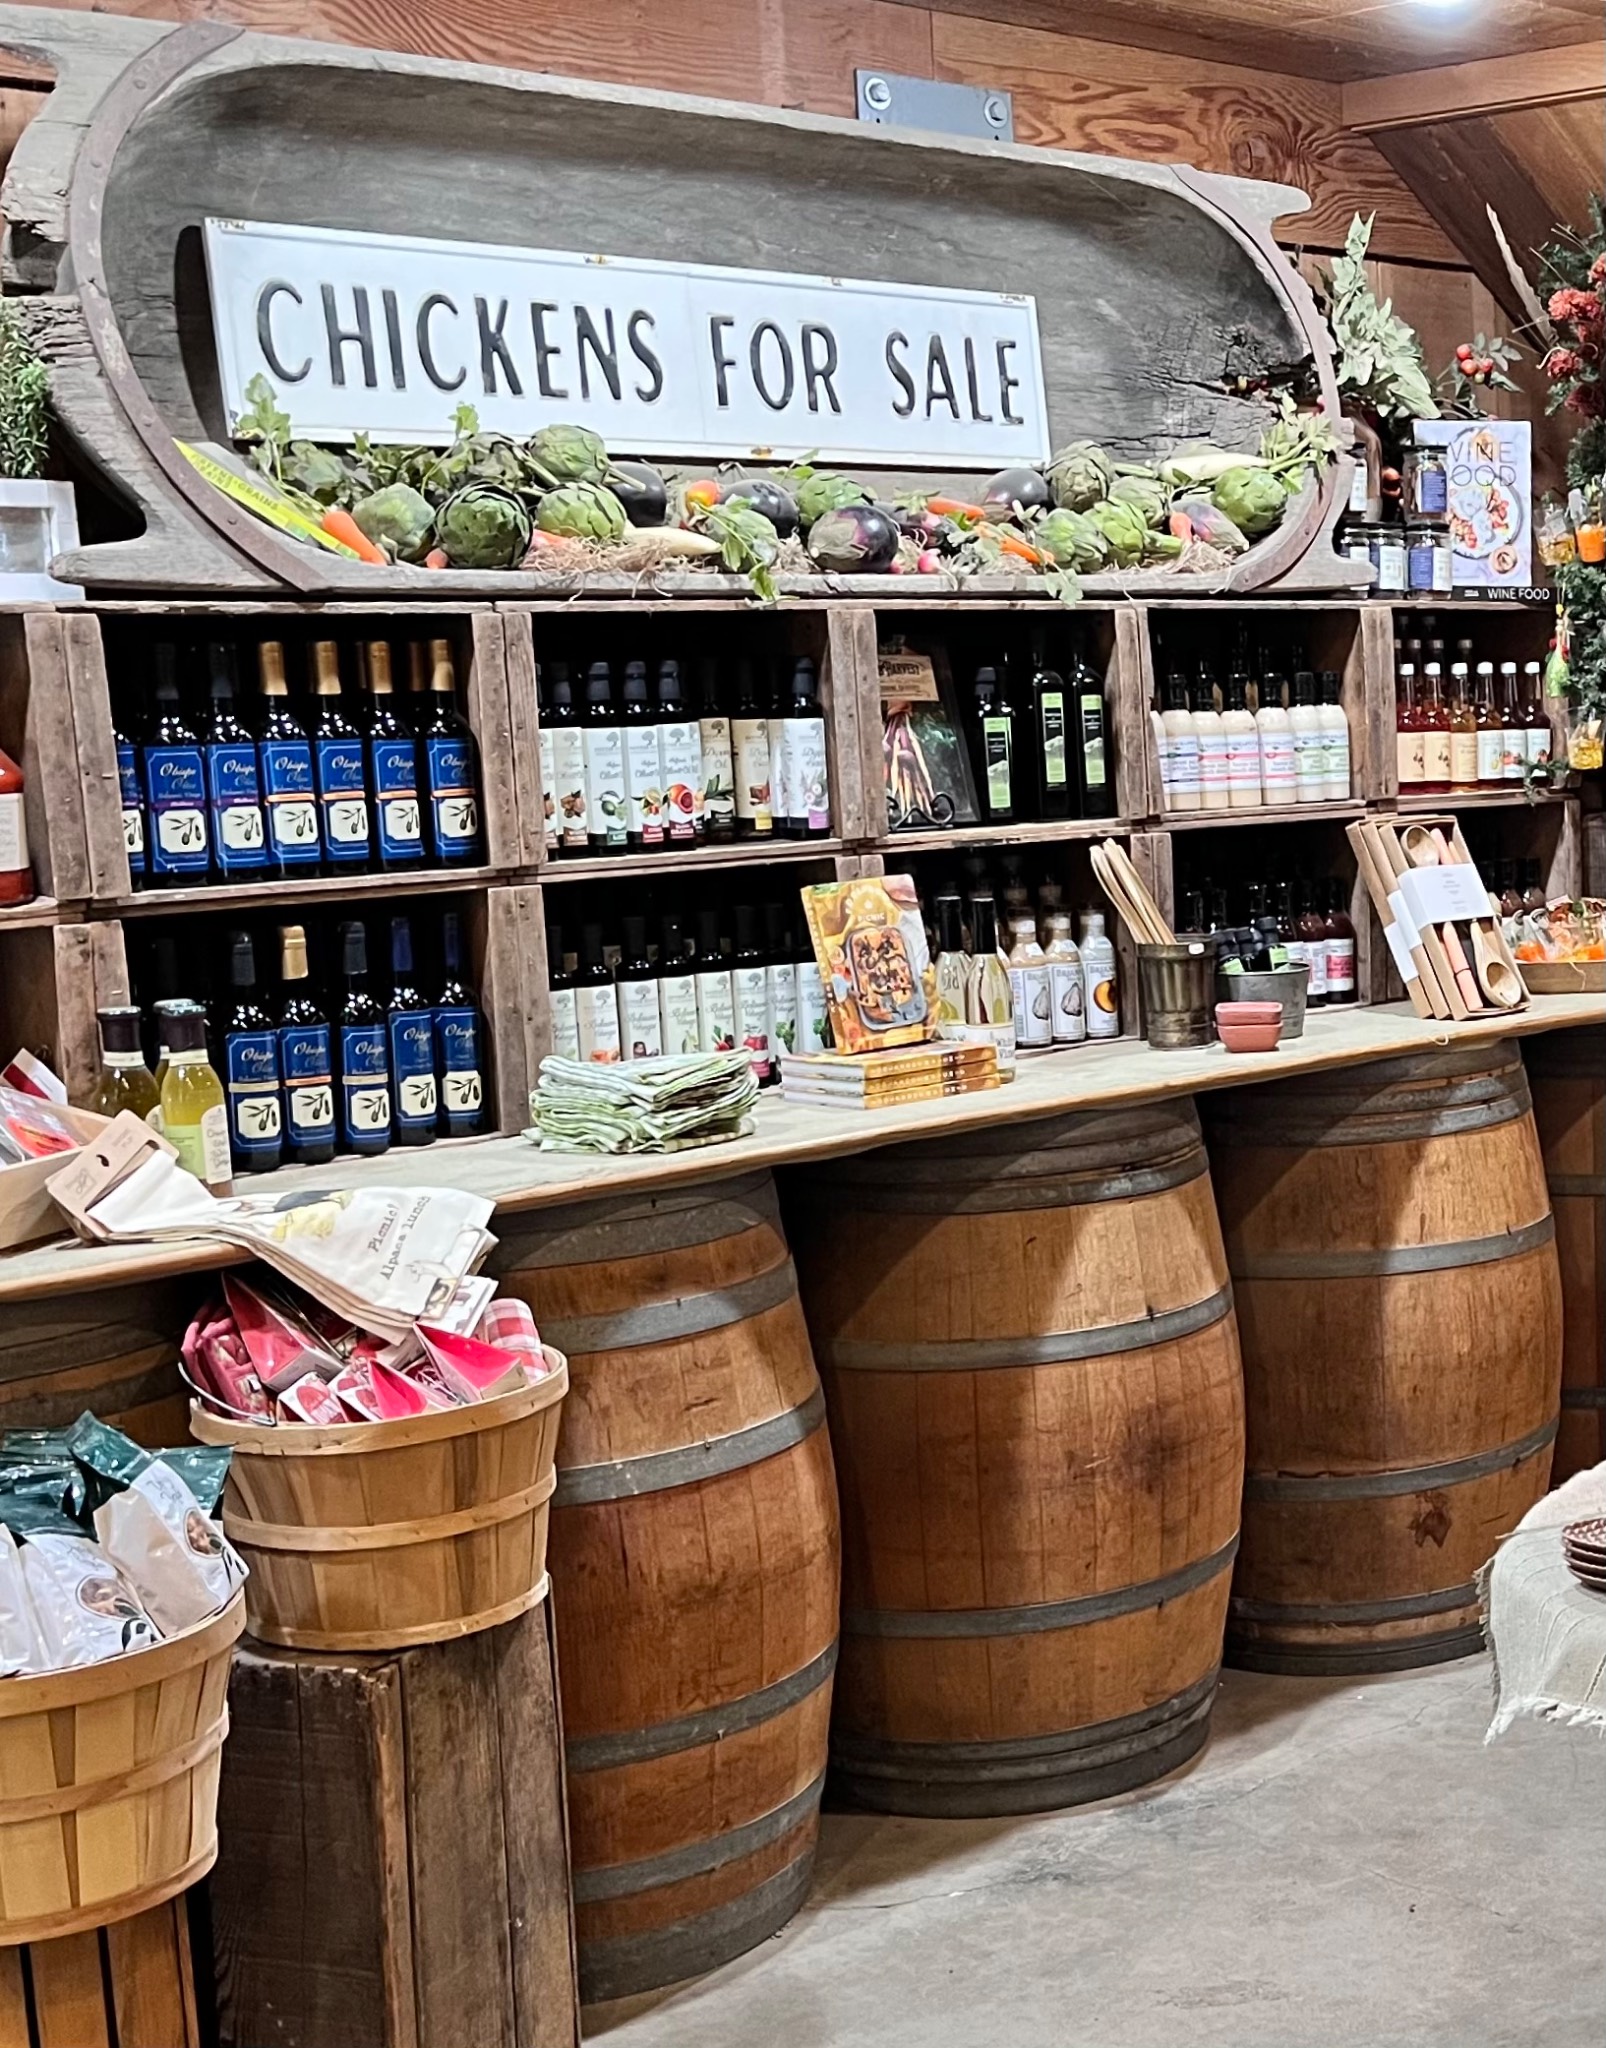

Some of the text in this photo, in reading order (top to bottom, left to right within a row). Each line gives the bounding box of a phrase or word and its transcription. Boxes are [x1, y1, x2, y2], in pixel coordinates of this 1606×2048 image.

[256, 278, 1025, 426] CHICKENS FOR SALE
[1451, 465, 1516, 486] OOD
[1487, 588, 1517, 600] WINE
[1518, 588, 1550, 600] FOOD
[367, 1203, 400, 1253] Picnic!
[380, 1234, 407, 1281] Alpaca
